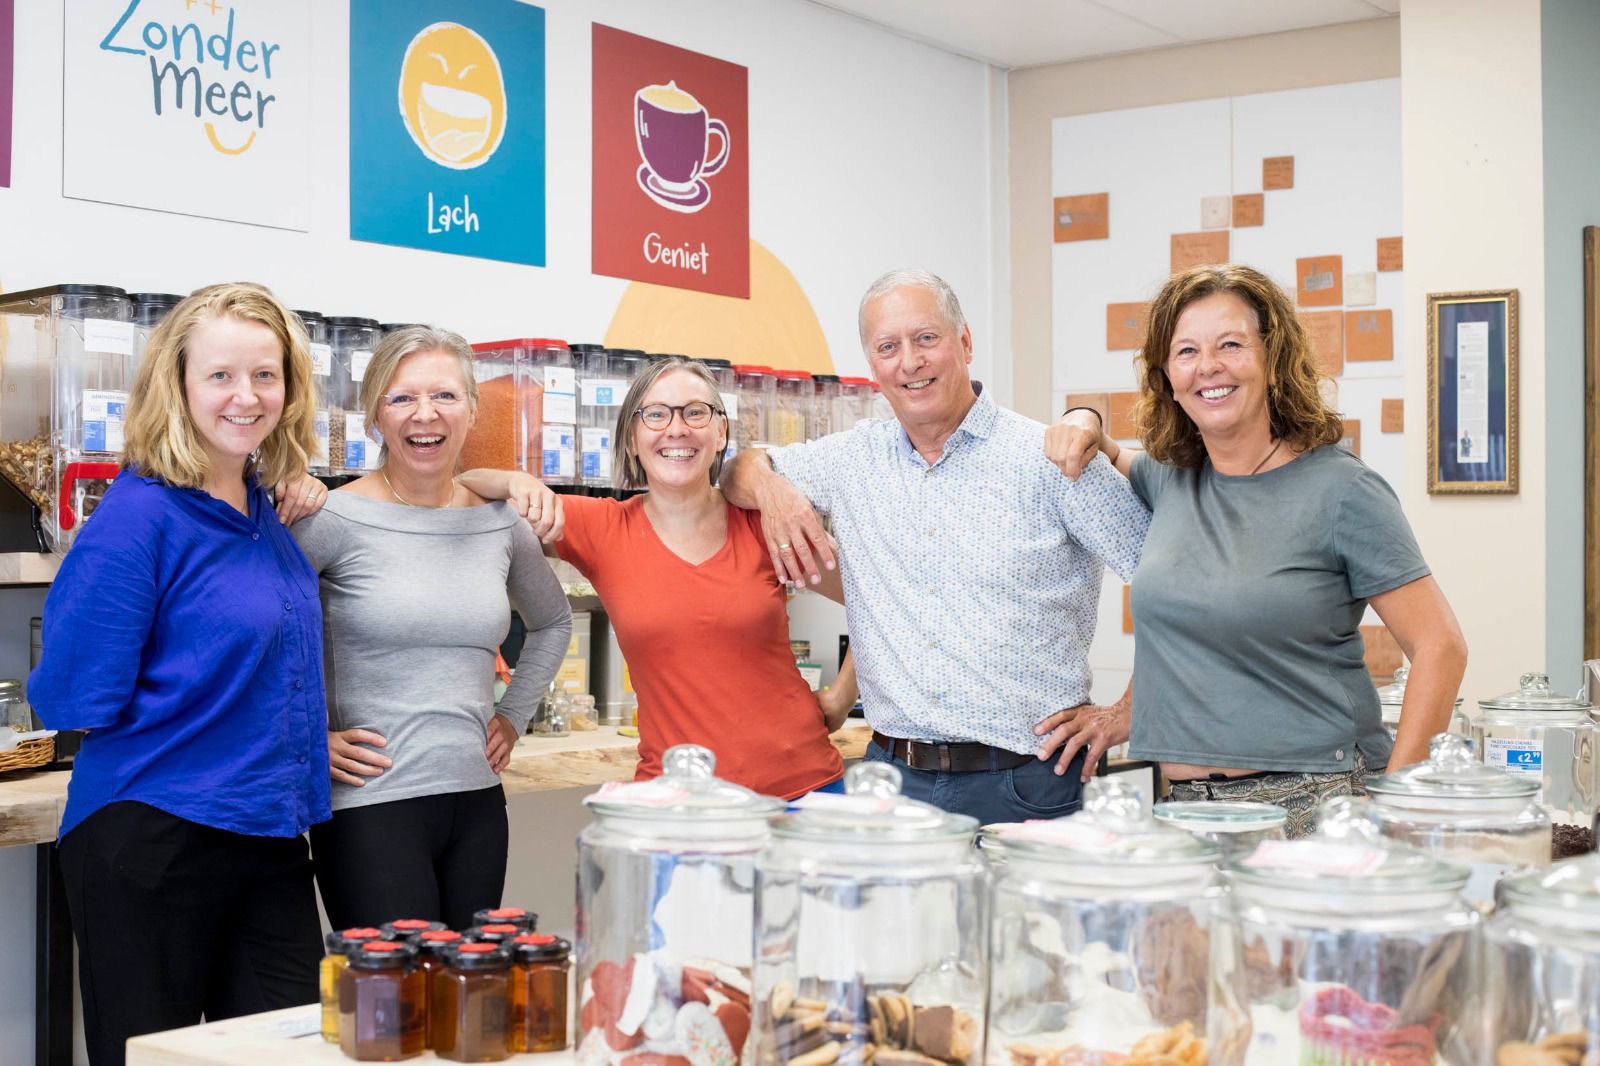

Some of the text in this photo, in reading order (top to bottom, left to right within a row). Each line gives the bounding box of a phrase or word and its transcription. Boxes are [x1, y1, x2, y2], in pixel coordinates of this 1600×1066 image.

[100, 0, 280, 79] Zonder
[428, 192, 479, 234] Lach
[643, 232, 709, 274] Geniet
